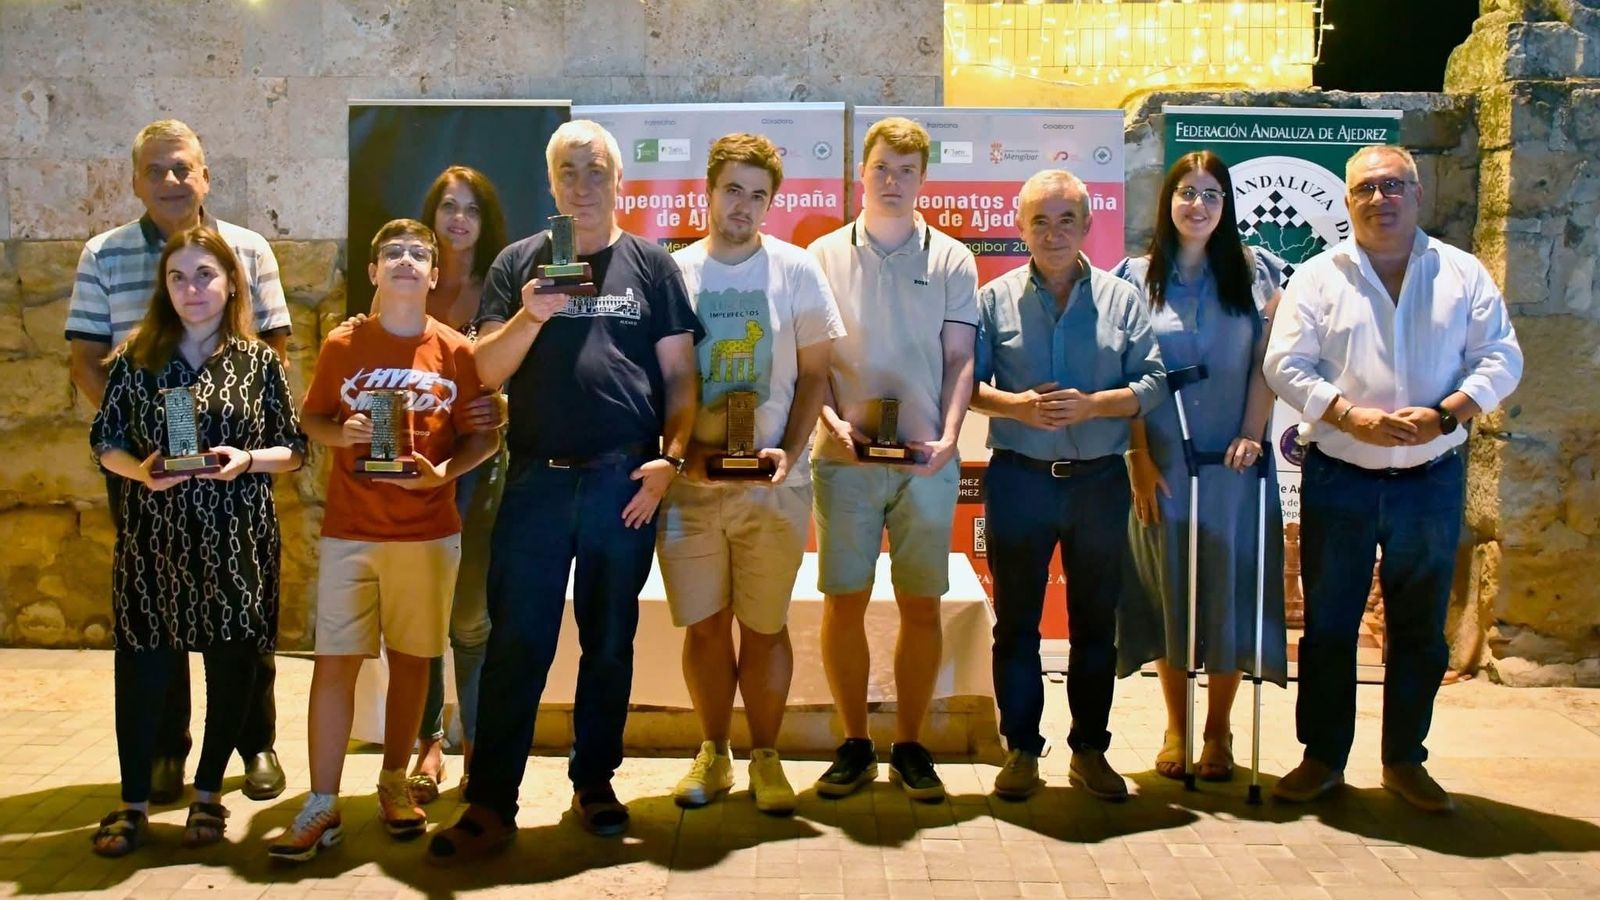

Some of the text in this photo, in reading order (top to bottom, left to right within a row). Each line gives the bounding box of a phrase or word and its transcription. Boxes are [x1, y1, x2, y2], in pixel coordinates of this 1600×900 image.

[1250, 123, 1315, 139] ANDALUZA
[1318, 127, 1334, 140] DE
[1337, 124, 1388, 143] AJEDREZ
[615, 191, 708, 215] mpeonato
[771, 190, 837, 213] spaña
[914, 192, 1004, 209] eonatos
[1235, 174, 1334, 211] ANDALUZA
[656, 209, 681, 227] de
[939, 209, 1015, 232] de Ajed
[1012, 241, 1031, 252] 20
[363, 368, 440, 390] HYPE
